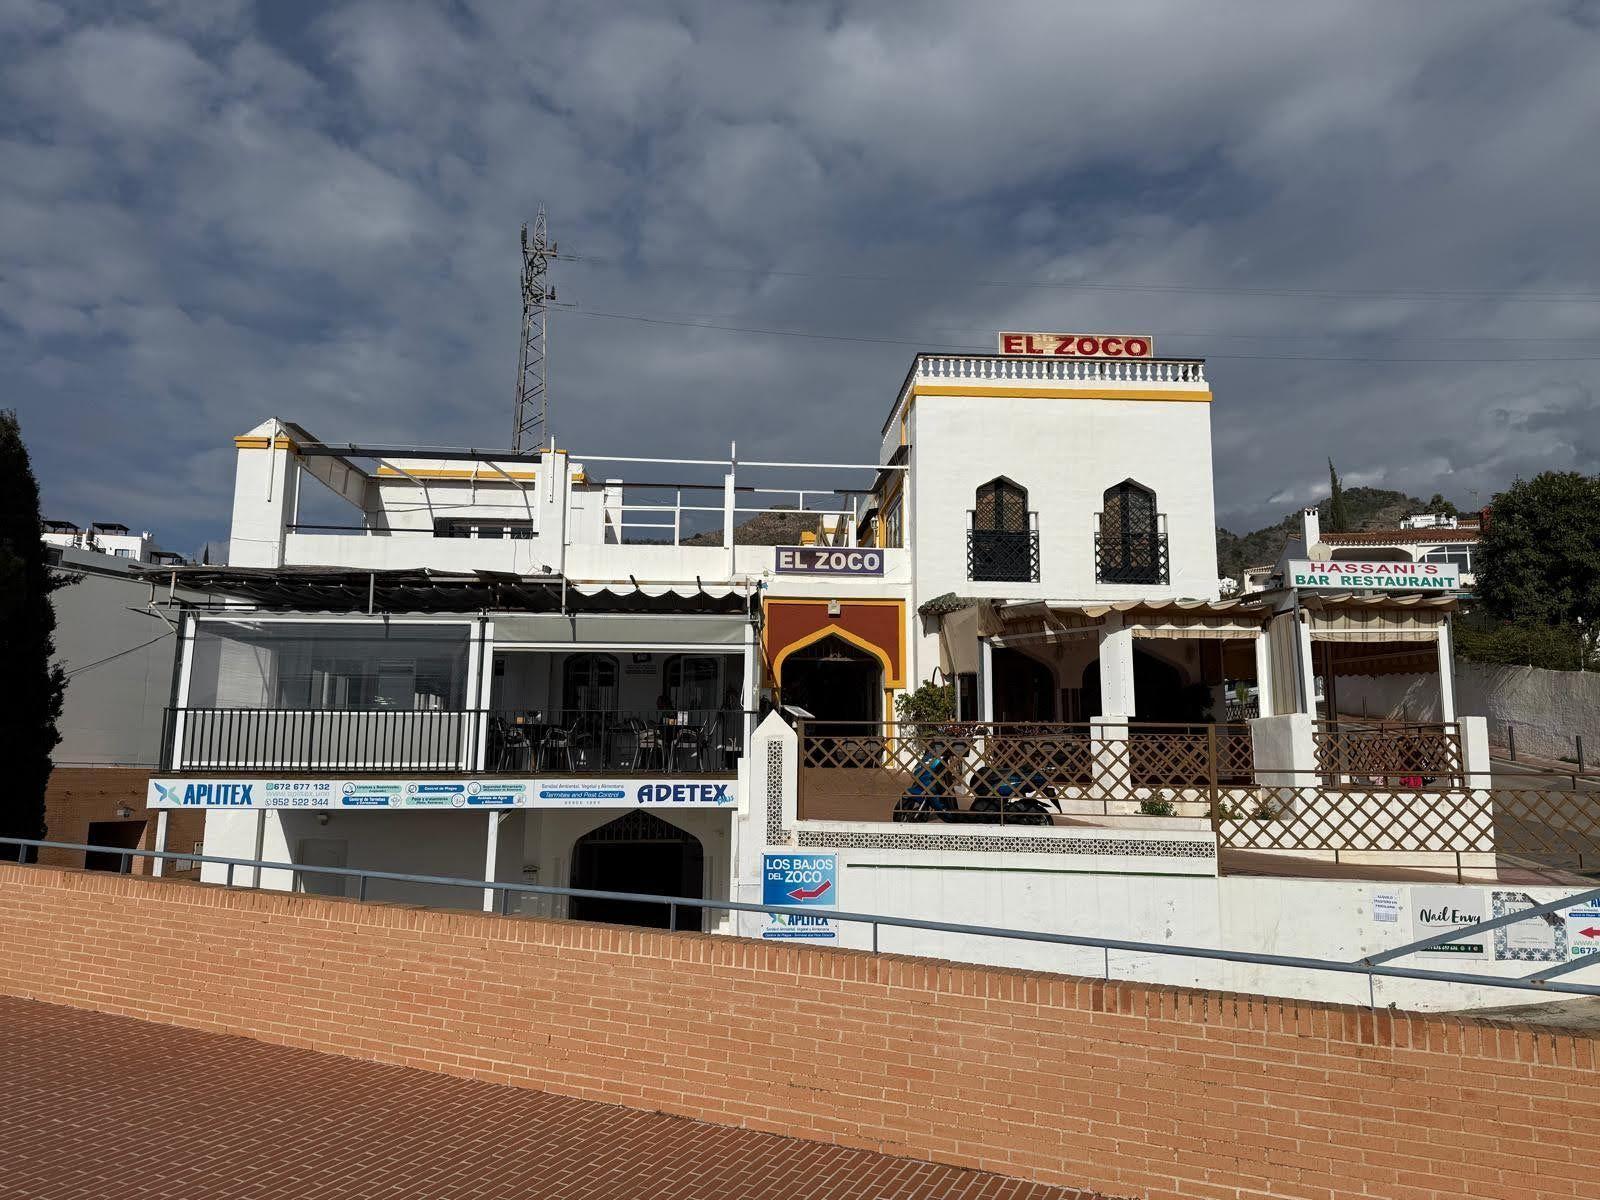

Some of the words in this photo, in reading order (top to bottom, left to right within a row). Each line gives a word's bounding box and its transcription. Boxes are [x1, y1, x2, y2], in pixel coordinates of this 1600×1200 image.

[1003, 335, 1044, 354] EL
[1054, 336, 1148, 357] ZOCO
[779, 551, 808, 569] EL
[814, 552, 880, 571] ZOCO
[1295, 575, 1330, 586] BAR
[1340, 575, 1455, 588] RESTAURANT
[183, 783, 253, 806] APLITEX
[273, 783, 291, 791] 672
[293, 783, 310, 791] 677
[313, 783, 330, 791] 132
[637, 784, 728, 804] ADETEX
[272, 798, 290, 806] 952
[292, 798, 309, 806] 522
[312, 798, 329, 806] 344
[766, 858, 791, 870] LOS
[793, 858, 834, 870] BAJOS
[768, 872, 784, 880] DEL
[784, 870, 822, 883] ZOCO
[1420, 906, 1450, 923] Nail
[1452, 909, 1480, 924] Envy
